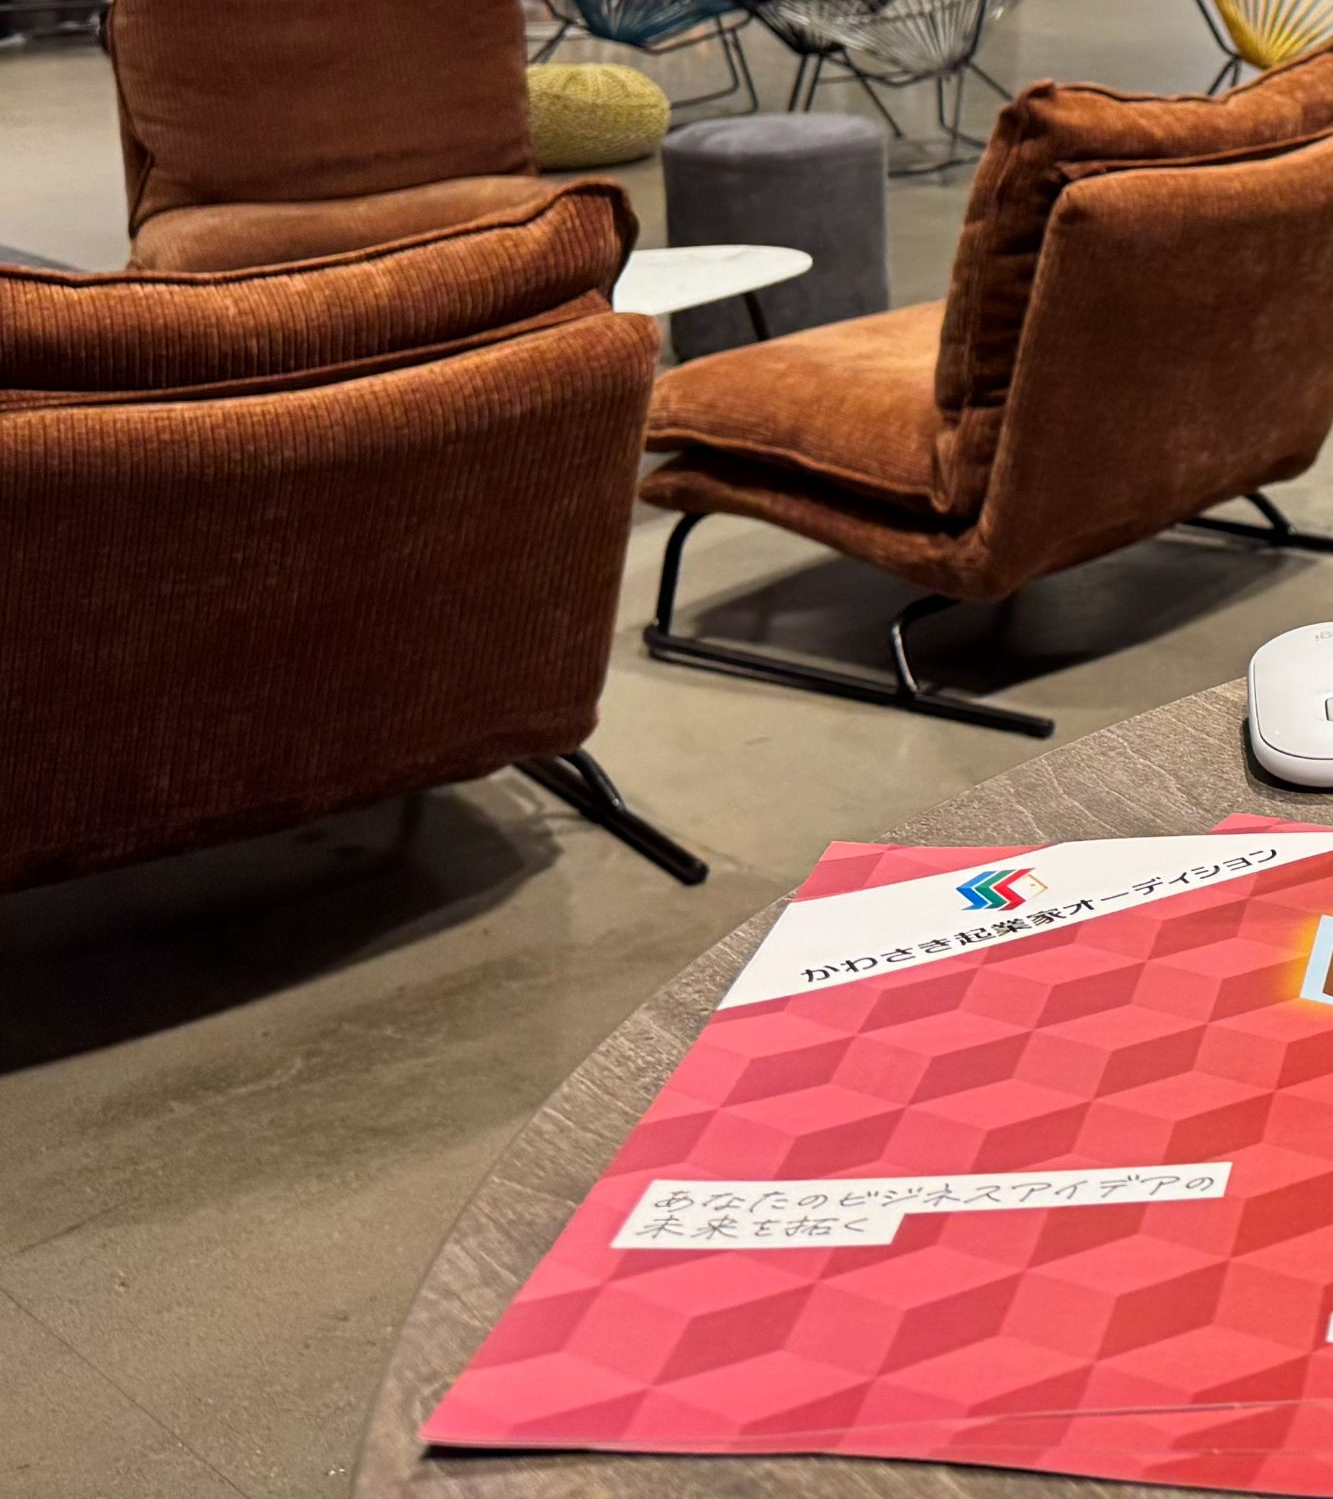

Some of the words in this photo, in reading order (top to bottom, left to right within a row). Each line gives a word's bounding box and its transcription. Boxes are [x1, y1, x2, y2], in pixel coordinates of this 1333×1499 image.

[799, 848, 1279, 984] かわさき起業家オーディション
[654, 1174, 1215, 1214] あなたのビジネスアイデアの
[635, 1216, 872, 1242] 未来を拓く
